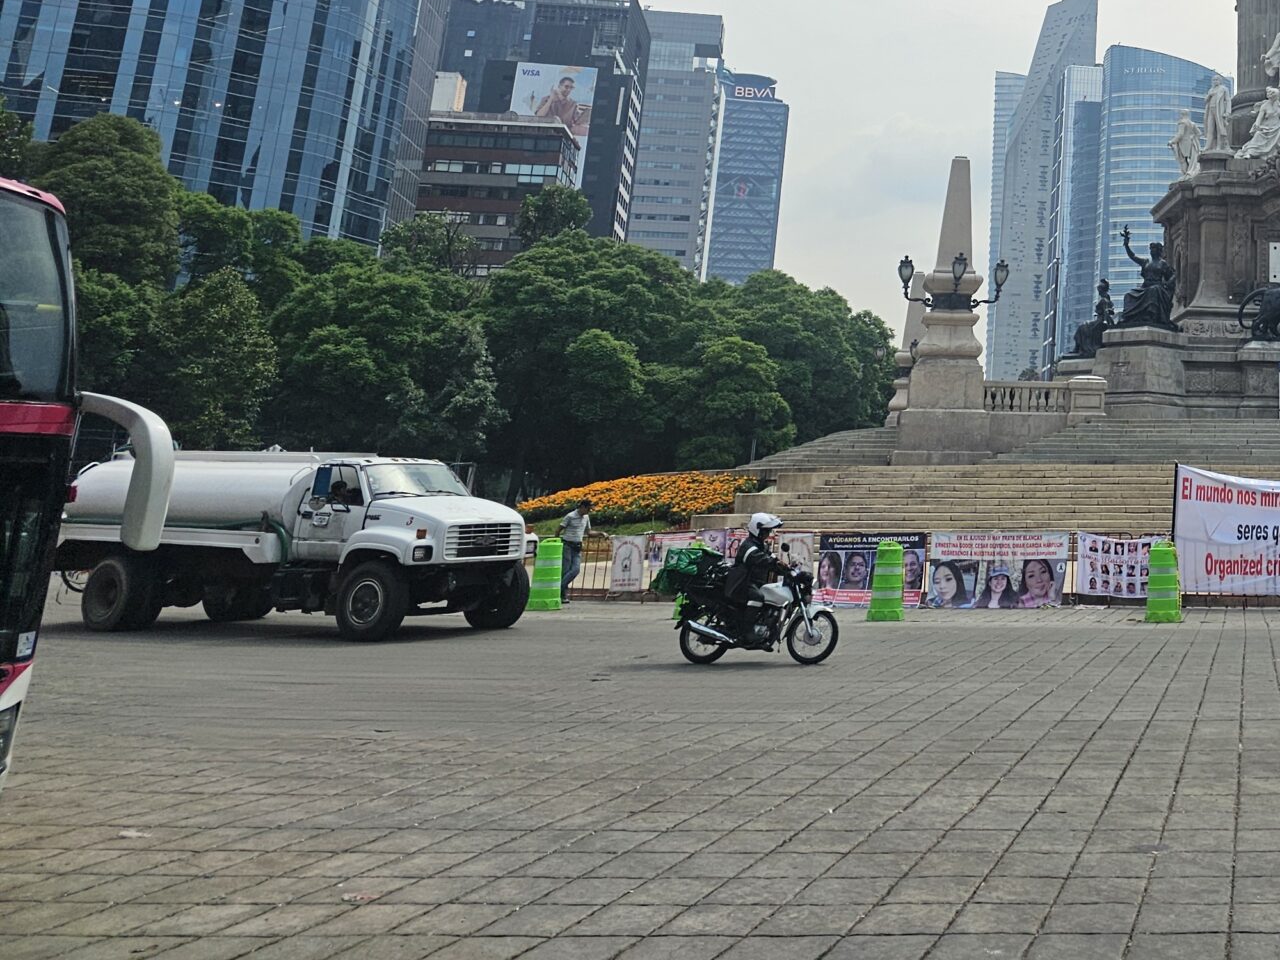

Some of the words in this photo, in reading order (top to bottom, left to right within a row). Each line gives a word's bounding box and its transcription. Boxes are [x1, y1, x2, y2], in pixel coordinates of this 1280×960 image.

[735, 86, 773, 98] BBVA
[1181, 477, 1193, 500] El
[1196, 483, 1233, 504] mundo
[1237, 490, 1257, 506] nos
[828, 535, 861, 543] AYÚDANOS
[868, 535, 919, 543] ENCONTRARLOS
[1237, 524, 1269, 541] seres
[1205, 552, 1263, 581] Organized
